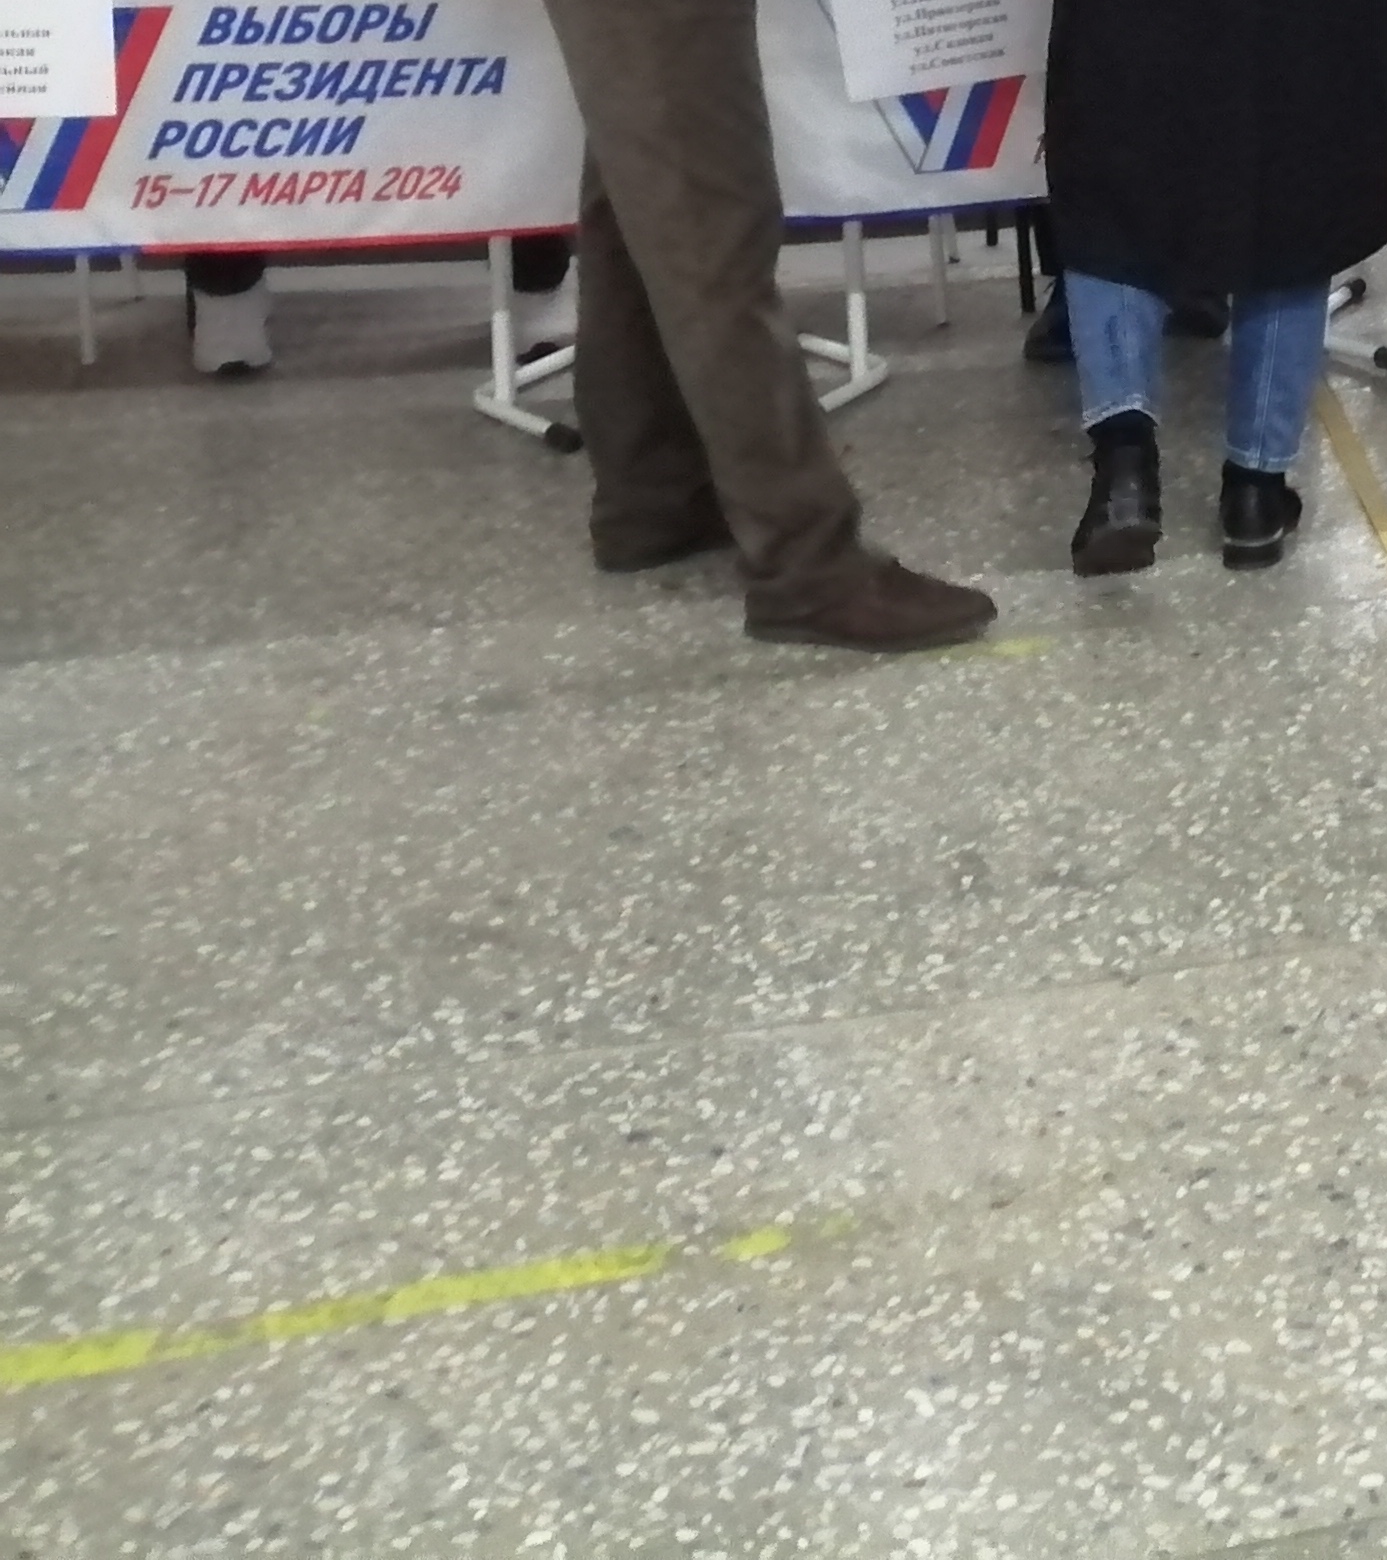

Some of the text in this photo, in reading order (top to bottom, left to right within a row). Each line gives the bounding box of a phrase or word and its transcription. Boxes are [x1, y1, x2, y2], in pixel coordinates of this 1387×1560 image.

[196, 3, 439, 46] ВЫБОРЫ
[171, 56, 508, 106] ПРЕЗИДЕНТА
[148, 115, 366, 161] РОССИИ
[239, 170, 368, 206] МАРТА
[373, 166, 464, 201] 2024
